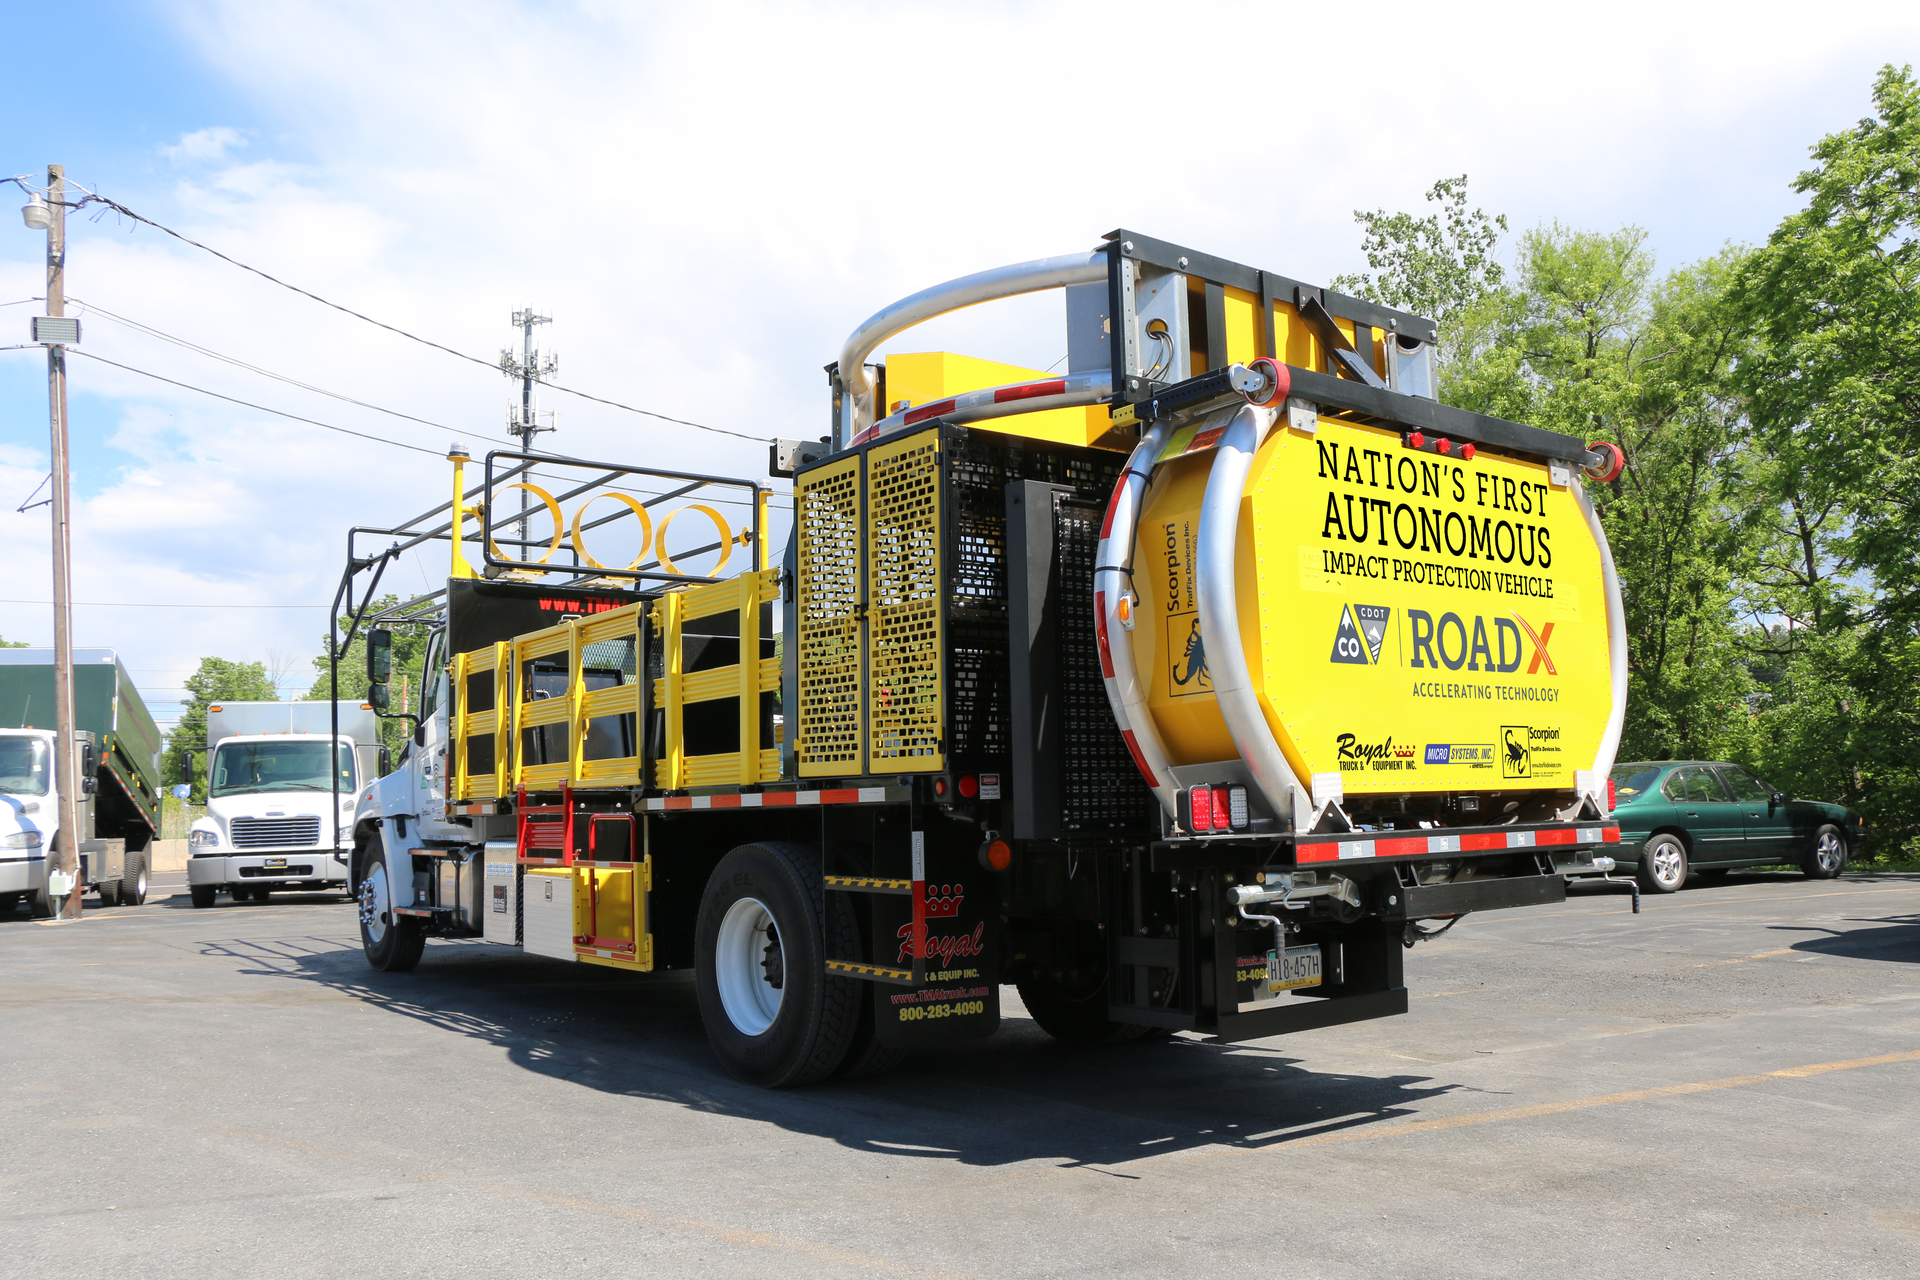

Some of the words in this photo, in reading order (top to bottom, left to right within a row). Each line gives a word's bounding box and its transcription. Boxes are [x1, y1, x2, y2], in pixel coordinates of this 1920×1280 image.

[1316, 439, 1465, 502] NATION'S
[1475, 471, 1548, 517] FIRST
[1321, 491, 1552, 569] AUTONOMOUS
[1164, 522, 1181, 612] Scorpion
[1322, 549, 1389, 580] IMPACT
[1392, 558, 1492, 592] PROTECTION
[1494, 572, 1554, 599] VEHICLE
[1360, 607, 1385, 619] CDOT
[1338, 636, 1360, 658] CO
[1412, 682, 1492, 700] ACCELERATING
[1495, 685, 1560, 702] TECHNOLOGY
[1529, 726, 1560, 742] Scorpion
[1336, 733, 1392, 766] Royal
[1427, 747, 1449, 760] MICRO
[1451, 748, 1480, 761] SYSTEMS,
[1481, 747, 1493, 760] INC.
[1339, 761, 1359, 771] TRUCK
[1360, 761, 1364, 771] &
[1372, 760, 1403, 772] EQUIPMENT
[1406, 760, 1417, 770] INC.
[897, 921, 984, 968] Royal
[929, 973, 937, 982] &
[938, 970, 962, 981] EQUIP
[963, 968, 980, 978] INC.
[891, 986, 989, 1004] www.TMAtruck.com
[899, 1001, 984, 1021] 800-283-4090
